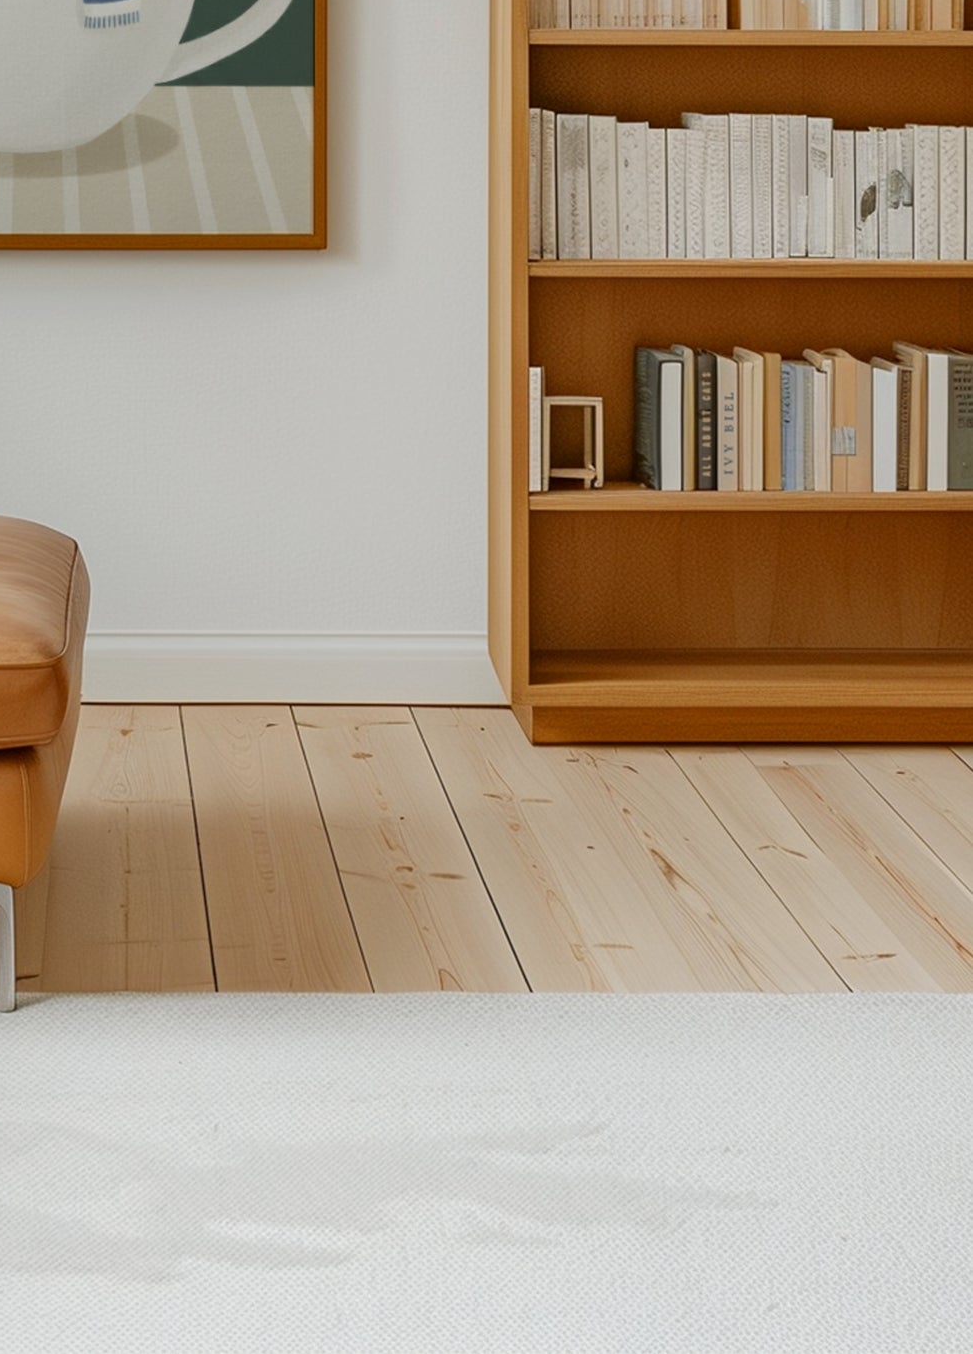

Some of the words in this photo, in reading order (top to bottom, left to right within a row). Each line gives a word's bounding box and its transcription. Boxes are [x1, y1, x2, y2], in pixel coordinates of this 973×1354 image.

[702, 371, 712, 401] CATS
[723, 391, 734, 433] BIEL
[702, 409, 712, 448] ABOUT
[702, 455, 712, 478] ALL
[723, 444, 734, 476] IVY
